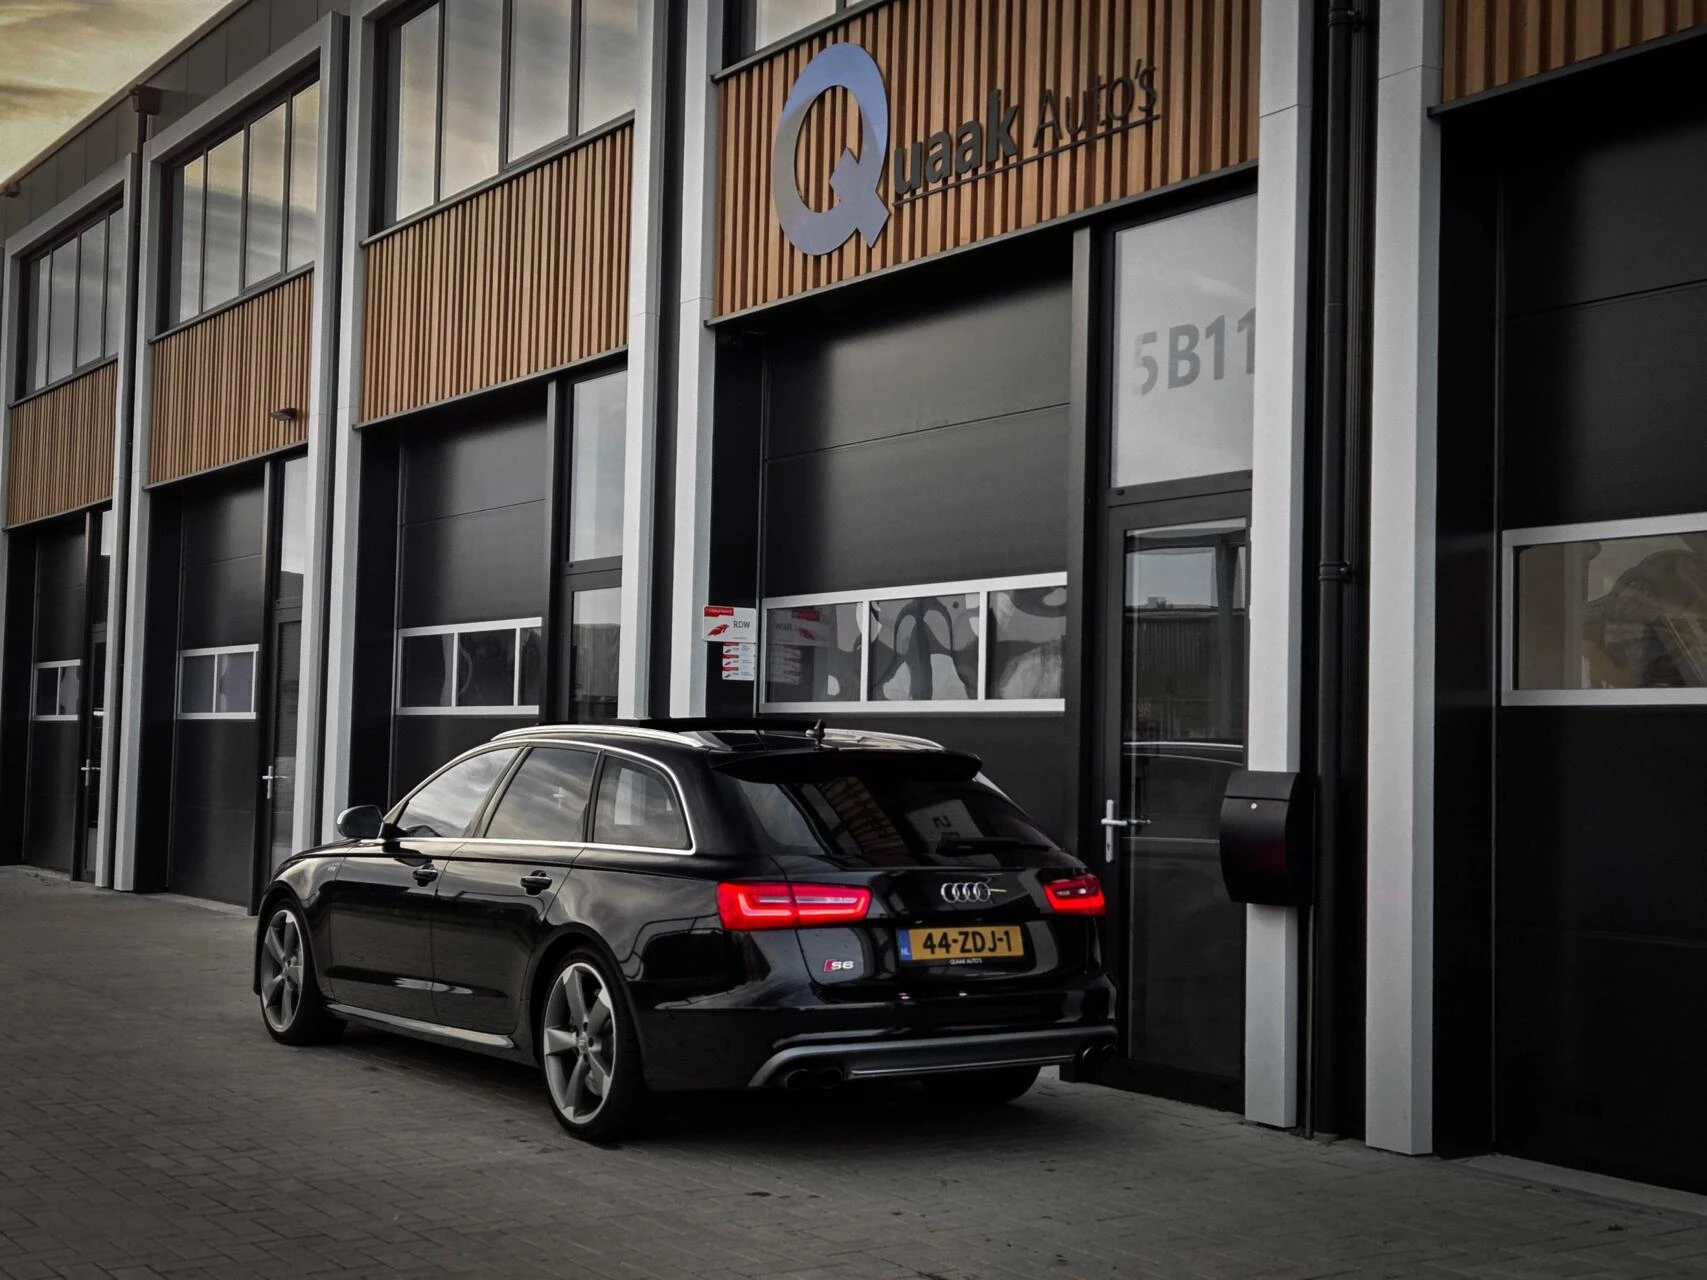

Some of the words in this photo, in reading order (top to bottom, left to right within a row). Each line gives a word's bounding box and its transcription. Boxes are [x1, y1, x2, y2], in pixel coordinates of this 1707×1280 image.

[772, 42, 1019, 256] Quaak
[1033, 58, 1158, 148] Auto's
[1133, 307, 1256, 396] 5B11
[733, 621, 751, 629] RDW
[923, 930, 1012, 954] 44-ZDJ-1
[900, 947, 911, 956] NL
[831, 961, 854, 970] S6
